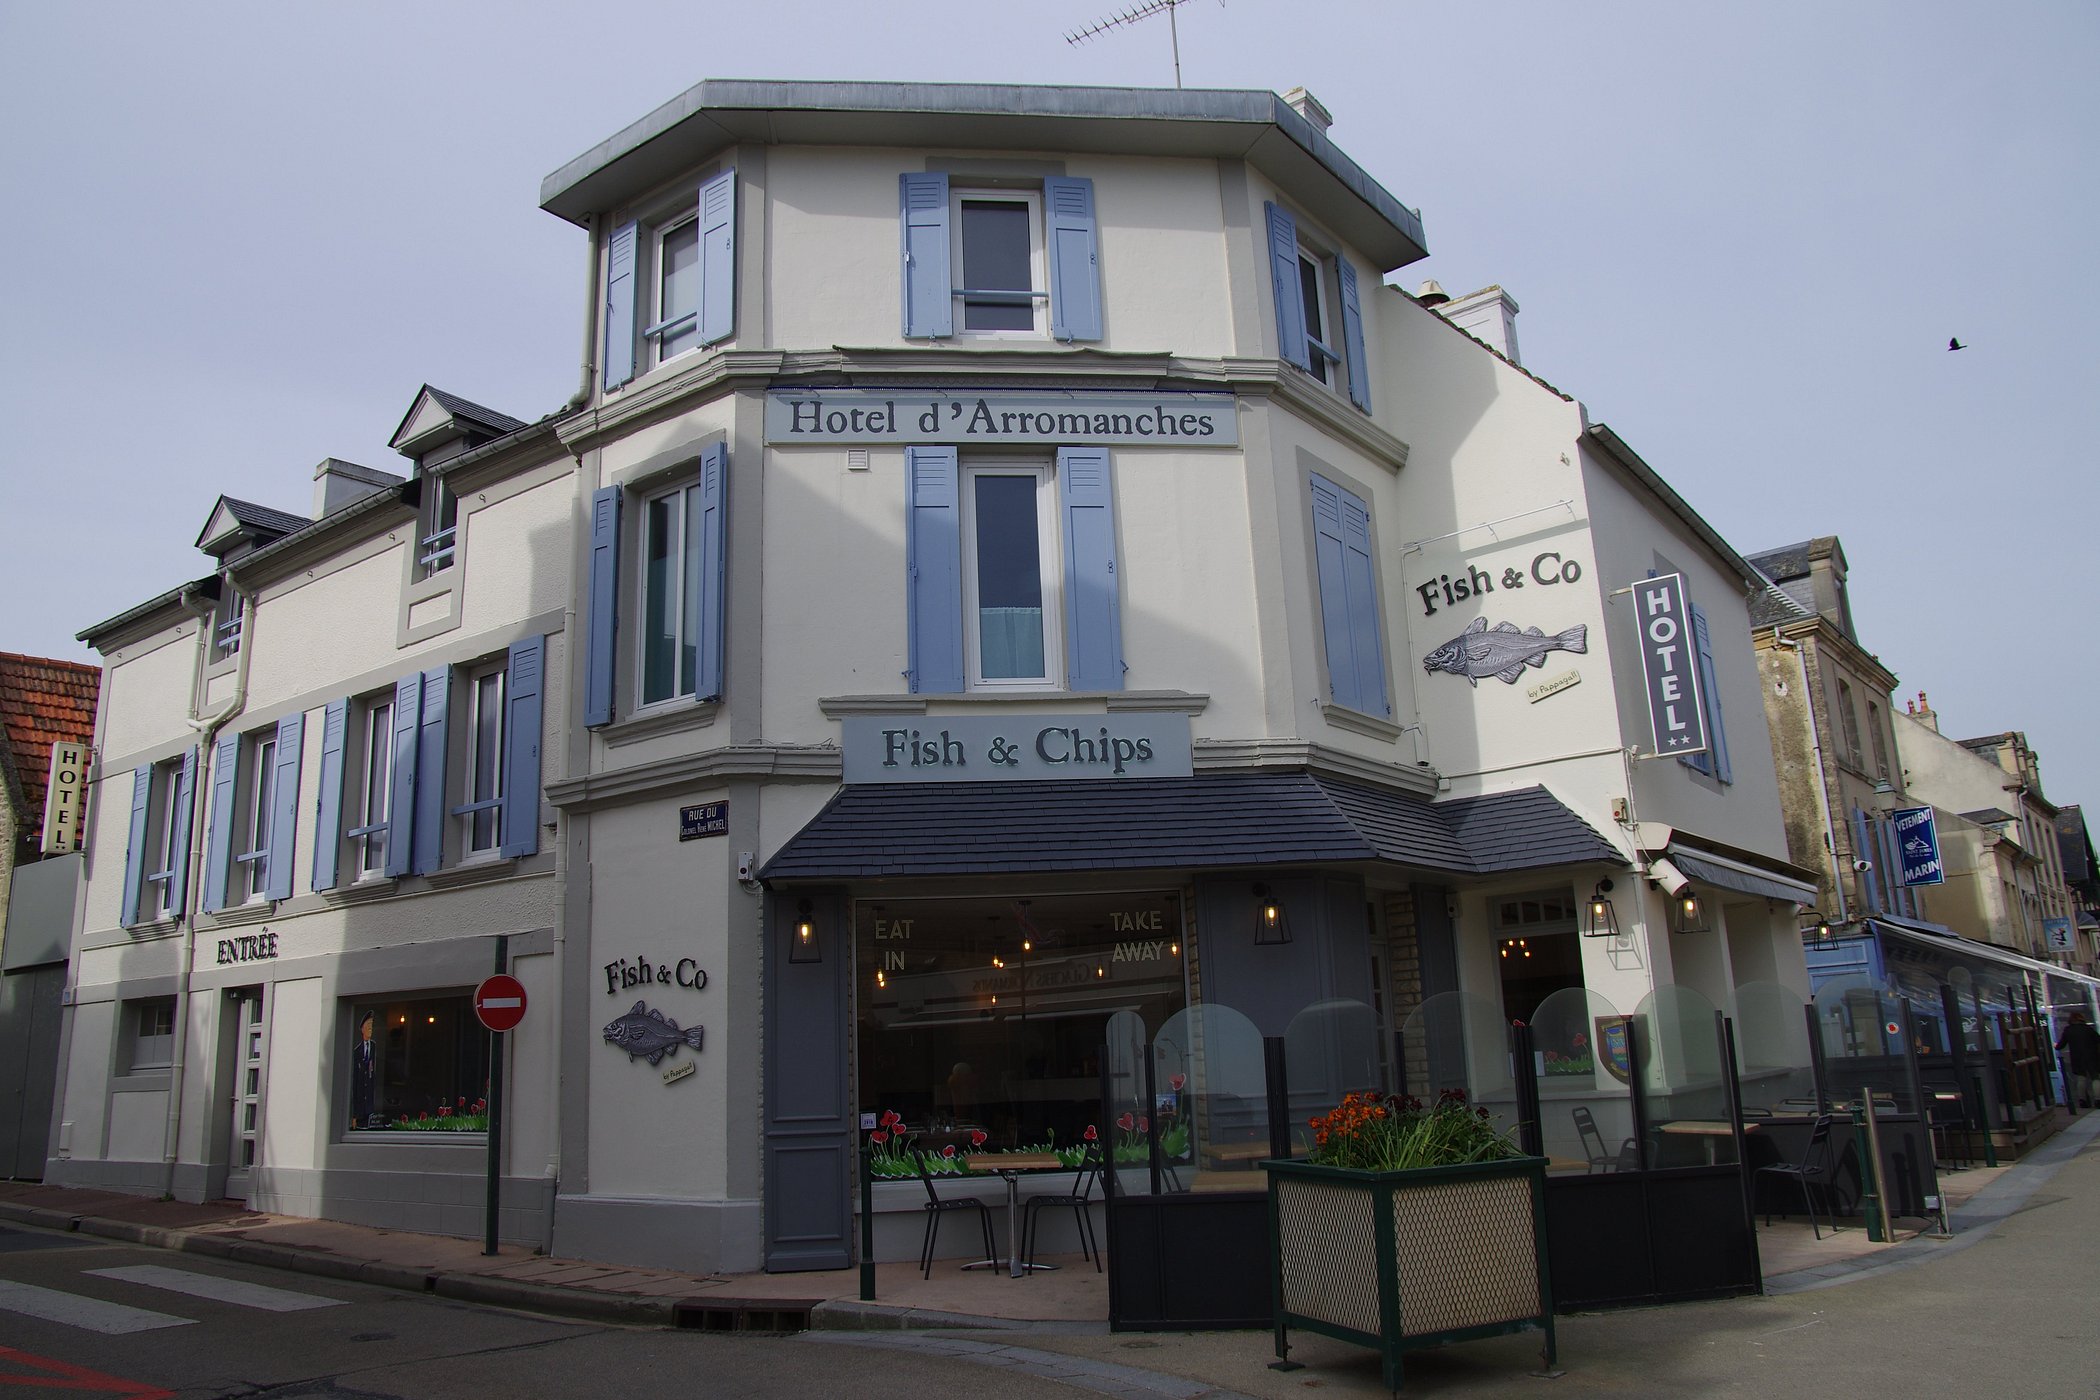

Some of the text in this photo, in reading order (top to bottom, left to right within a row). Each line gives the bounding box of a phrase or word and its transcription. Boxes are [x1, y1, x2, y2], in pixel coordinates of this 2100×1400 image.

[790, 399, 1215, 436] Hotel d'Arromanches
[1416, 552, 1582, 617] Fish & Co
[1646, 586, 1687, 731] HOTEL
[1528, 671, 1578, 698] by Pappagall
[882, 727, 1153, 775] Fish & Chips
[56, 750, 78, 844] HOTEL
[688, 806, 717, 822] RUE DU
[1896, 809, 1931, 831] VETEMENT
[1905, 859, 1940, 882] MARIN
[875, 919, 914, 940] EAT
[1109, 910, 1163, 932] TAKE
[216, 926, 279, 965] ENTRÉE
[1111, 941, 1165, 963] AWAY
[885, 951, 905, 971] IN
[604, 955, 708, 995] Fish & Co
